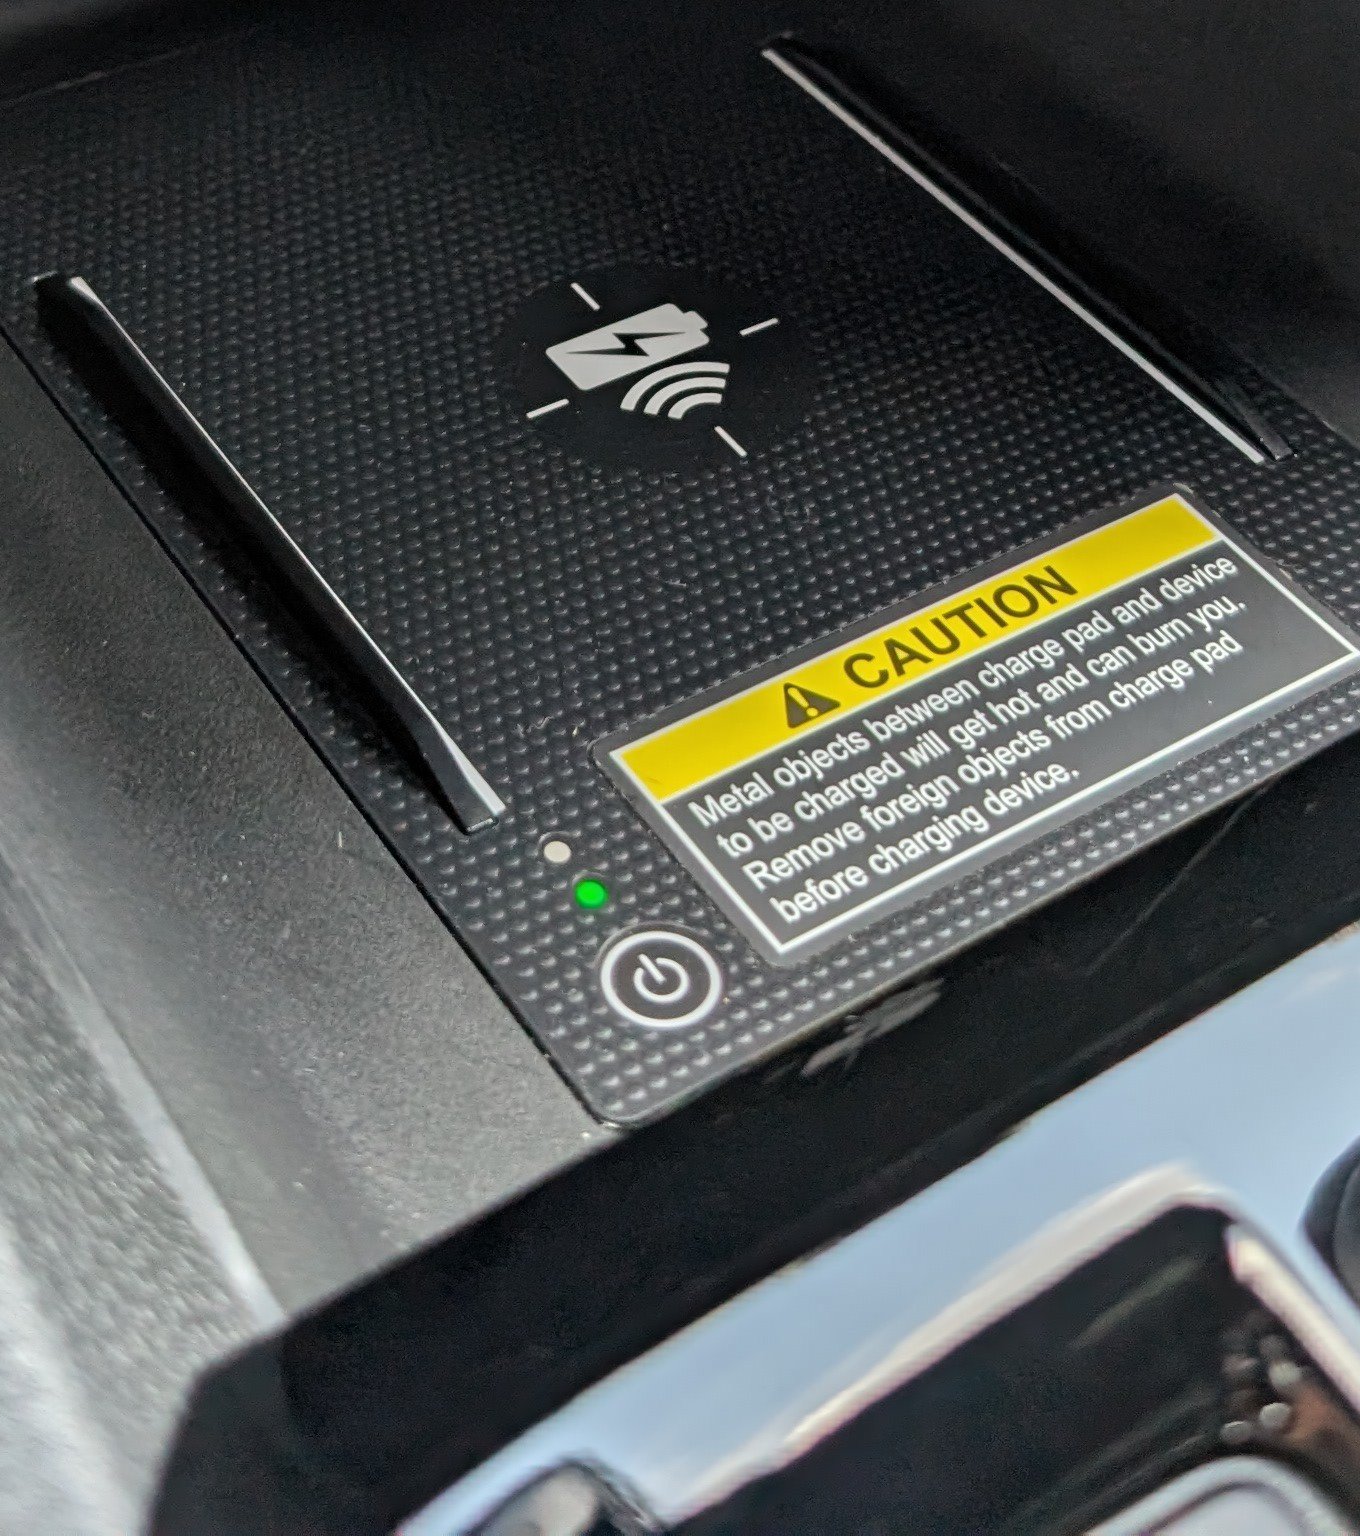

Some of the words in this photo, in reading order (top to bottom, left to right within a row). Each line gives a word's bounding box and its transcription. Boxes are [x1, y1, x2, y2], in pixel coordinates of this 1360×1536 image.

[688, 772, 775, 827] Metal
[773, 731, 871, 787] objects
[863, 678, 981, 741] between
[978, 638, 1065, 688] charge
[1061, 610, 1115, 653] pad
[1112, 587, 1163, 624] and
[1159, 557, 1238, 601] device
[717, 832, 753, 859] to
[747, 812, 794, 843] be
[794, 752, 905, 820] charged
[900, 730, 951, 768] will
[949, 709, 1000, 750] get
[987, 688, 1041, 725] hot
[1037, 663, 1089, 703] and
[1086, 645, 1138, 677] can
[1127, 616, 1193, 655] burn
[1187, 595, 1247, 633] you.
[843, 565, 1078, 688] CAUTION
[742, 821, 865, 892] Remove
[860, 774, 960, 832] foreign
[957, 732, 1052, 785] objects
[1044, 698, 1113, 740] from
[1108, 657, 1194, 708] charge
[1190, 629, 1244, 674] pad
[770, 864, 869, 924] before
[867, 805, 989, 875] charging
[983, 763, 1080, 816] device.
